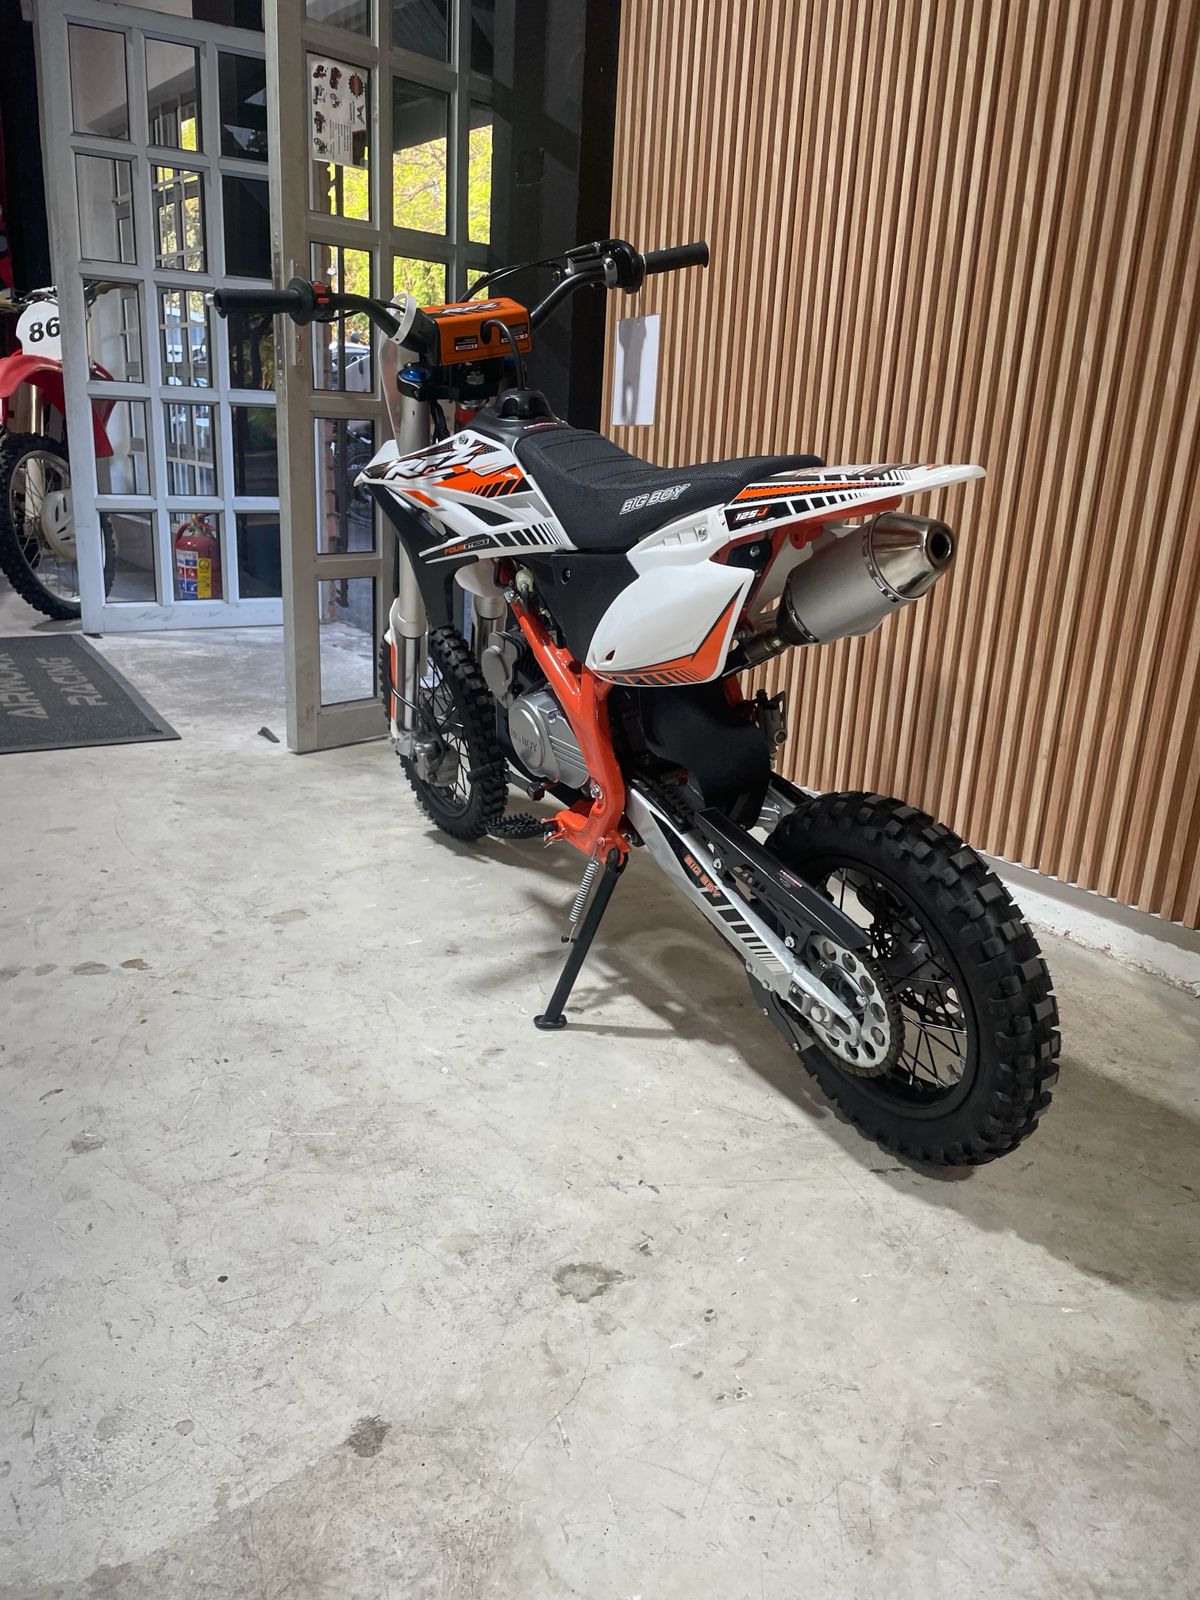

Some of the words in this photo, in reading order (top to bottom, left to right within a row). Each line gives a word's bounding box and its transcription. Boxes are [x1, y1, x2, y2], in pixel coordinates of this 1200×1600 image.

[29, 317, 60, 342] 86
[620, 493, 650, 515] BIG
[646, 483, 692, 506] BOY
[35, 657, 108, 705] RACING
[683, 854, 702, 877] BIG
[699, 873, 722, 898] BOY
